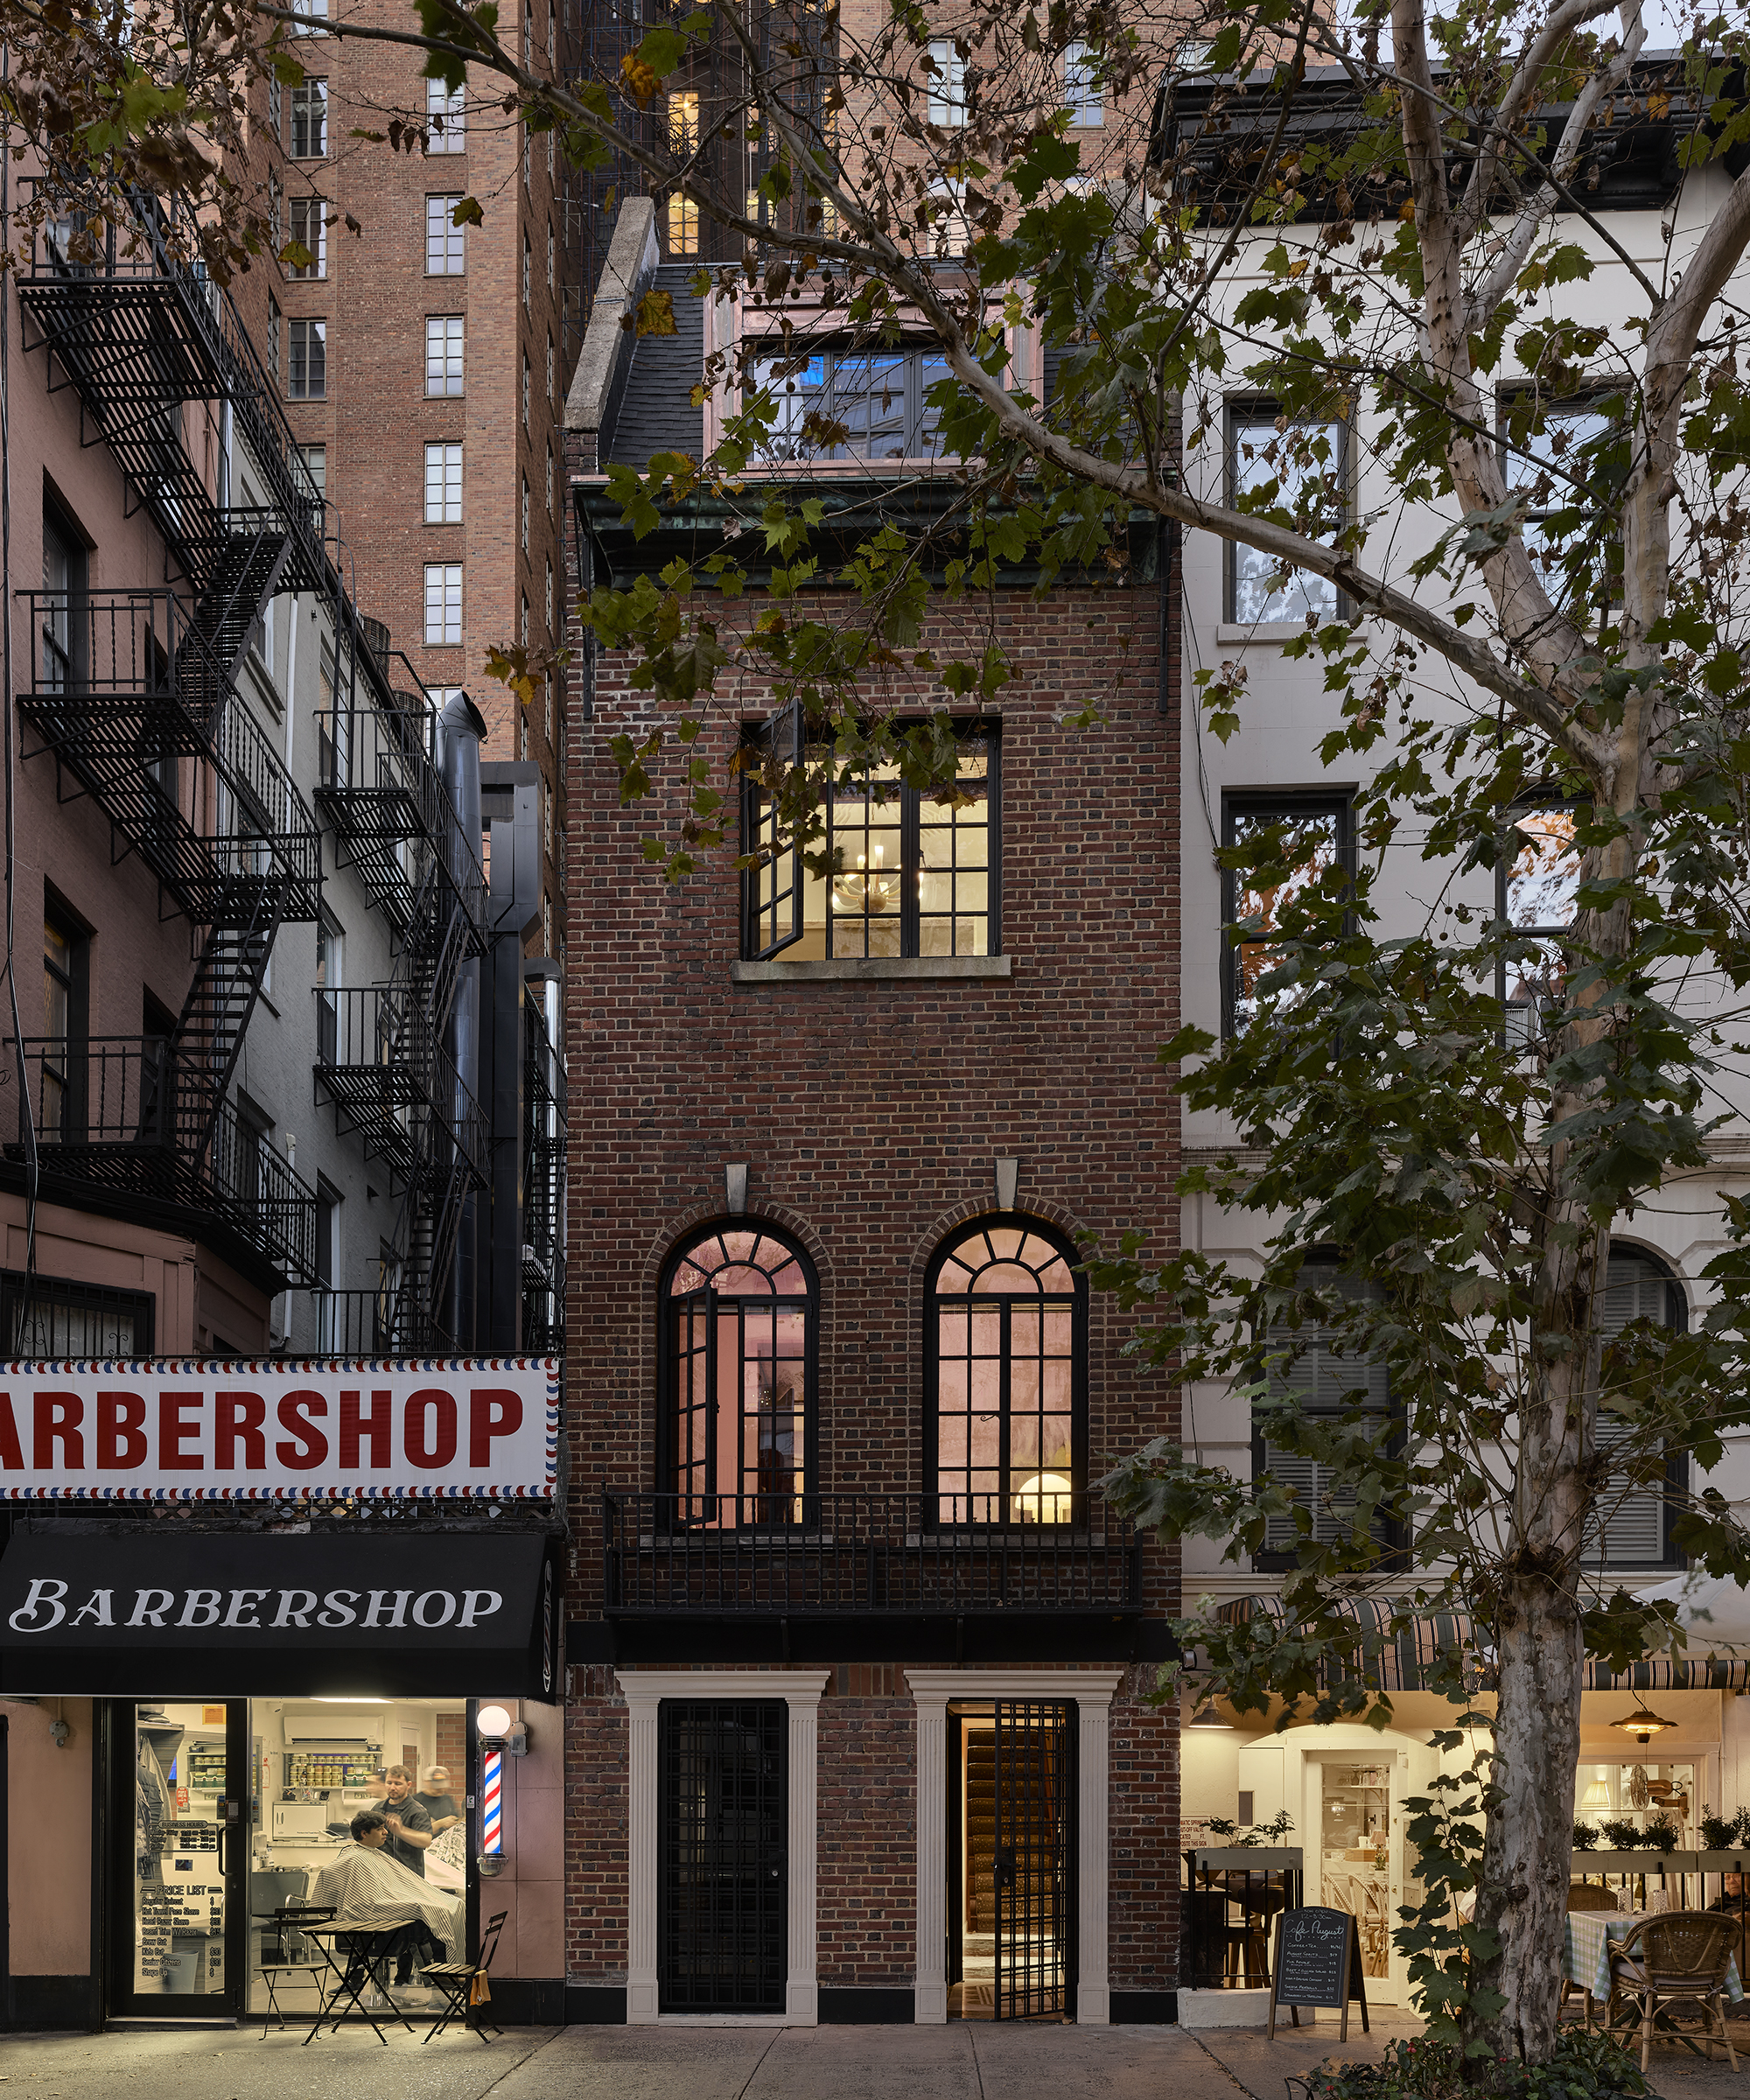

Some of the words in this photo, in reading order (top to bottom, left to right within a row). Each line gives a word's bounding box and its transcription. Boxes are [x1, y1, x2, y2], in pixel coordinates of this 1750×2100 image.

[9, 1578, 502, 1632] BARBERSHOP
[157, 1886, 184, 1895] PRICE
[186, 1886, 206, 1895] LIST
[142, 1897, 163, 1906] Regular
[210, 1927, 220, 1936] $15
[1312, 1920, 1344, 1941] August
[142, 1937, 156, 1946] Crew
[158, 1937, 167, 1946] Cut
[142, 1957, 159, 1966] Senior
[160, 1957, 181, 1966] Citizens
[142, 1968, 159, 1978] Shape
[159, 1968, 168, 1978] Up
